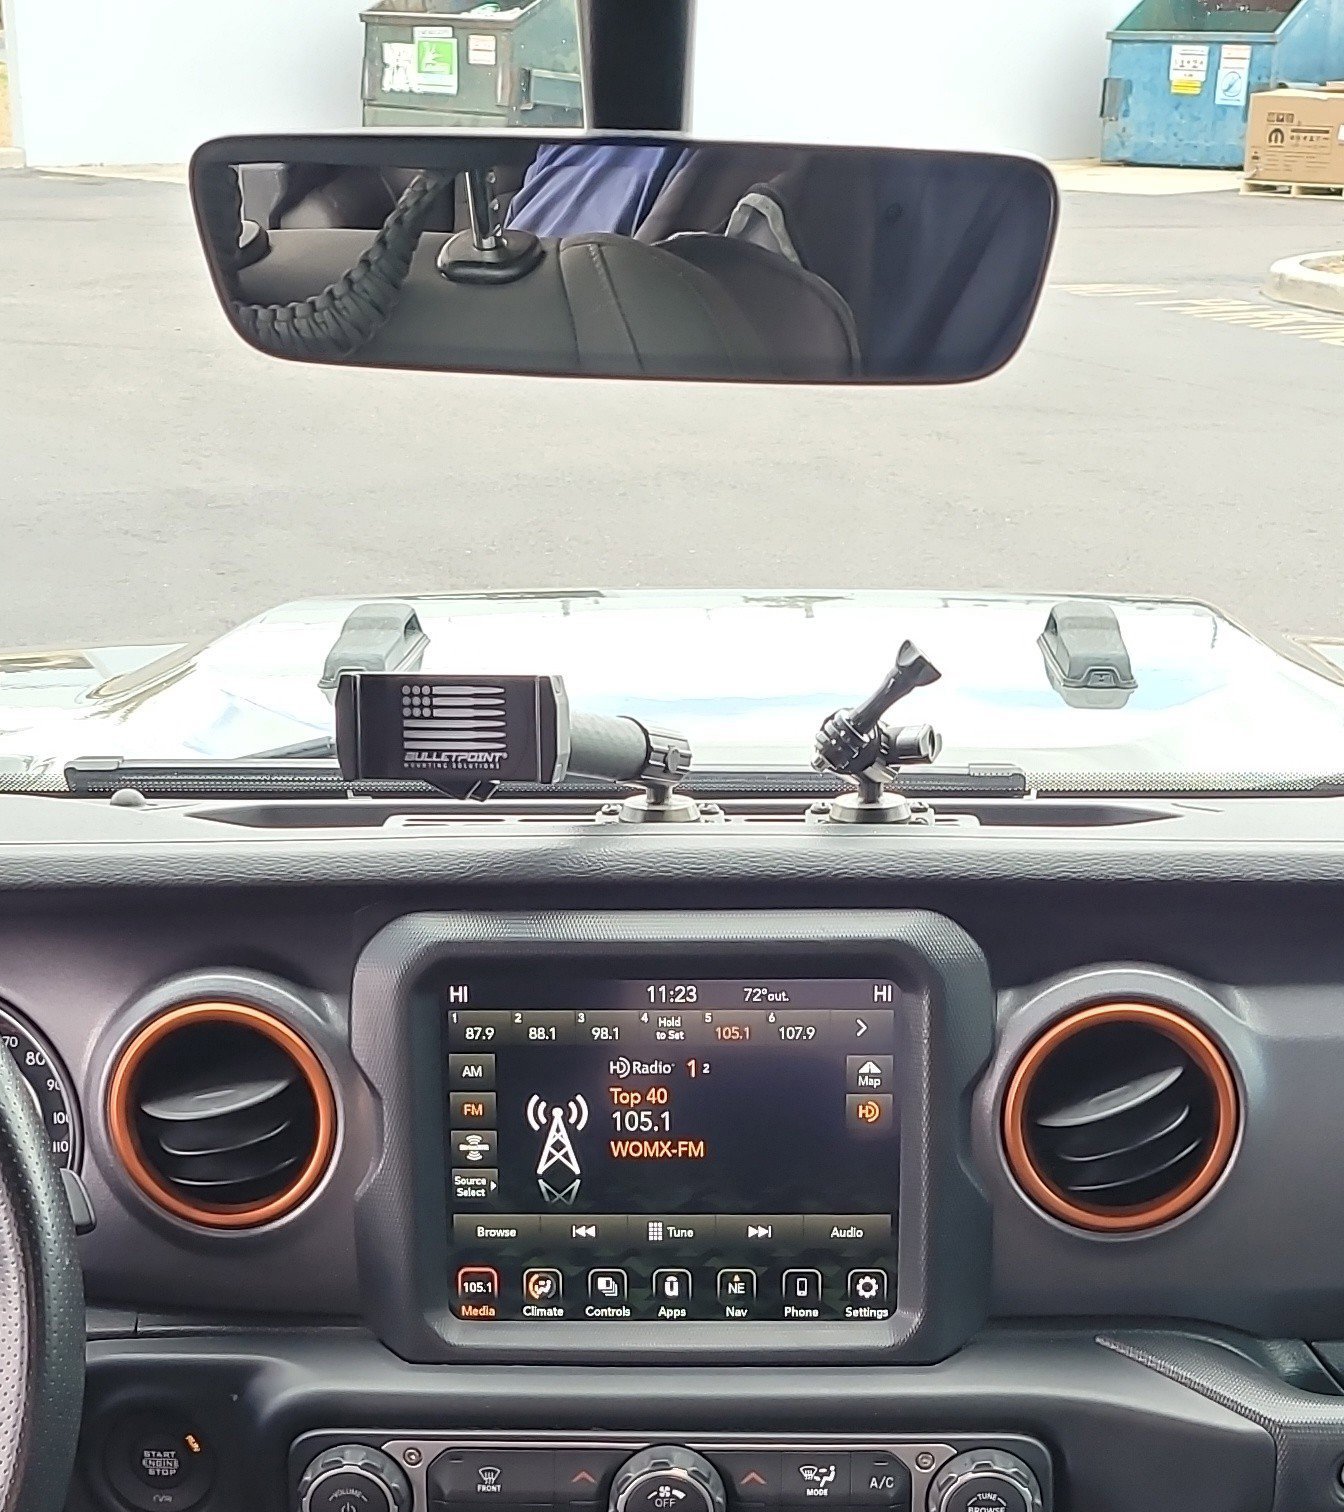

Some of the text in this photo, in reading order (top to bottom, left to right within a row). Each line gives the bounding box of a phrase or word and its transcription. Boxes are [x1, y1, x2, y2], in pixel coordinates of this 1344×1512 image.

[404, 752, 502, 762] BULLETPOINT
[449, 985, 468, 1003] HI
[647, 985, 698, 1003] 11:23
[873, 985, 892, 1003] HI
[452, 1012, 458, 1023] 1
[514, 1012, 523, 1023] 2
[577, 1012, 586, 1023] 3
[640, 1012, 649, 1023] 4
[658, 1016, 682, 1027] Hold
[704, 1012, 713, 1023] 5
[768, 1012, 776, 1023] 6
[465, 1027, 495, 1040] 87.9
[528, 1027, 556, 1040] 88.1
[591, 1027, 619, 1040] 98.1
[655, 1030, 685, 1040] to Set
[715, 1027, 750, 1040] 105.1
[778, 1027, 816, 1040] 107.9
[2, 1036, 18, 1048] 70
[25, 1052, 45, 1065] 80
[461, 1065, 483, 1078] AM
[632, 1060, 672, 1074] Radio
[687, 1059, 696, 1078] 1
[702, 1063, 711, 1074] 2
[858, 1076, 881, 1089] Map
[609, 1087, 668, 1108] Top 40
[463, 1103, 483, 1116] FM
[612, 1111, 670, 1132] 105.1
[52, 1141, 69, 1153] 110
[610, 1140, 705, 1158] WOMX-FM
[454, 1175, 487, 1186] Source
[456, 1187, 486, 1197] Select
[476, 1226, 517, 1238] Browse
[666, 1226, 694, 1238] Tune
[830, 1226, 864, 1238] Audio
[463, 1281, 493, 1293] 105.1
[728, 1282, 746, 1294] NE
[461, 1305, 496, 1317] Media
[522, 1305, 564, 1317] Climate
[585, 1305, 631, 1317] Controls
[658, 1306, 687, 1319] Apps
[725, 1306, 749, 1317] Nav
[784, 1306, 819, 1318] Phone
[845, 1306, 889, 1319] Settings
[143, 1450, 176, 1458] START
[142, 1459, 179, 1468] ENGINE
[477, 1484, 502, 1492] FRONT
[869, 1476, 894, 1489] A/C
[333, 1488, 363, 1498] VOLUME
[976, 1492, 998, 1501] TUNE
[654, 1499, 676, 1508] OFF
